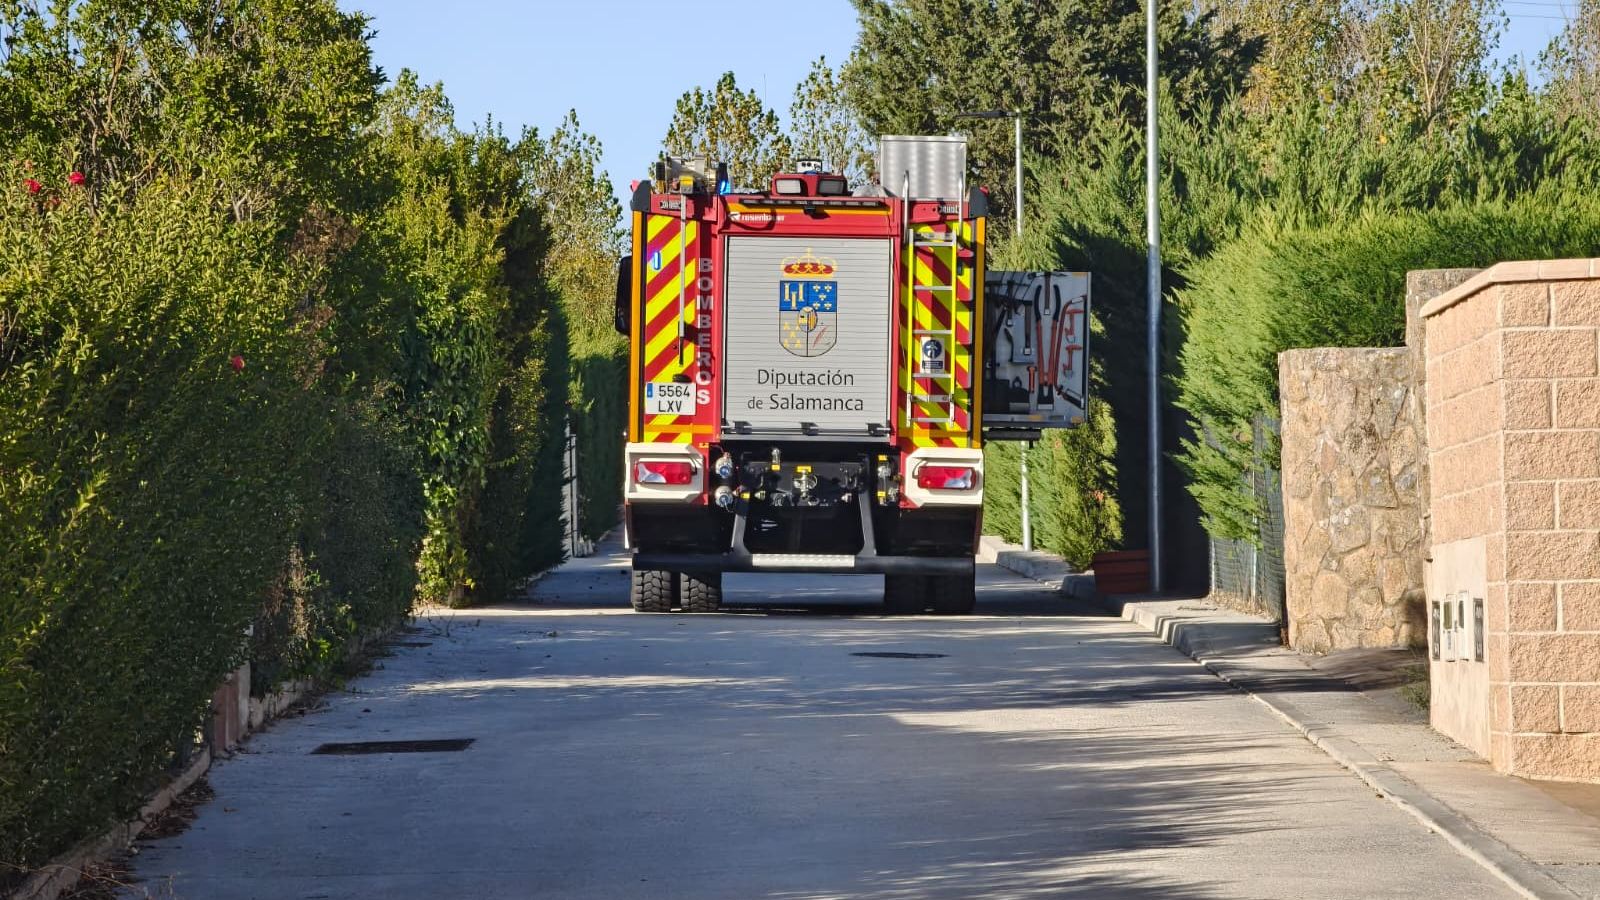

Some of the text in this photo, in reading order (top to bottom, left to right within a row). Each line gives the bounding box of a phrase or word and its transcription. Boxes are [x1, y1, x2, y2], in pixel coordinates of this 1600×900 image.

[696, 257, 714, 405] BOMBEROS
[757, 369, 854, 389] Diputación
[658, 385, 690, 397] 5564
[658, 400, 682, 412] LXV
[747, 393, 864, 411] de Salamanca
